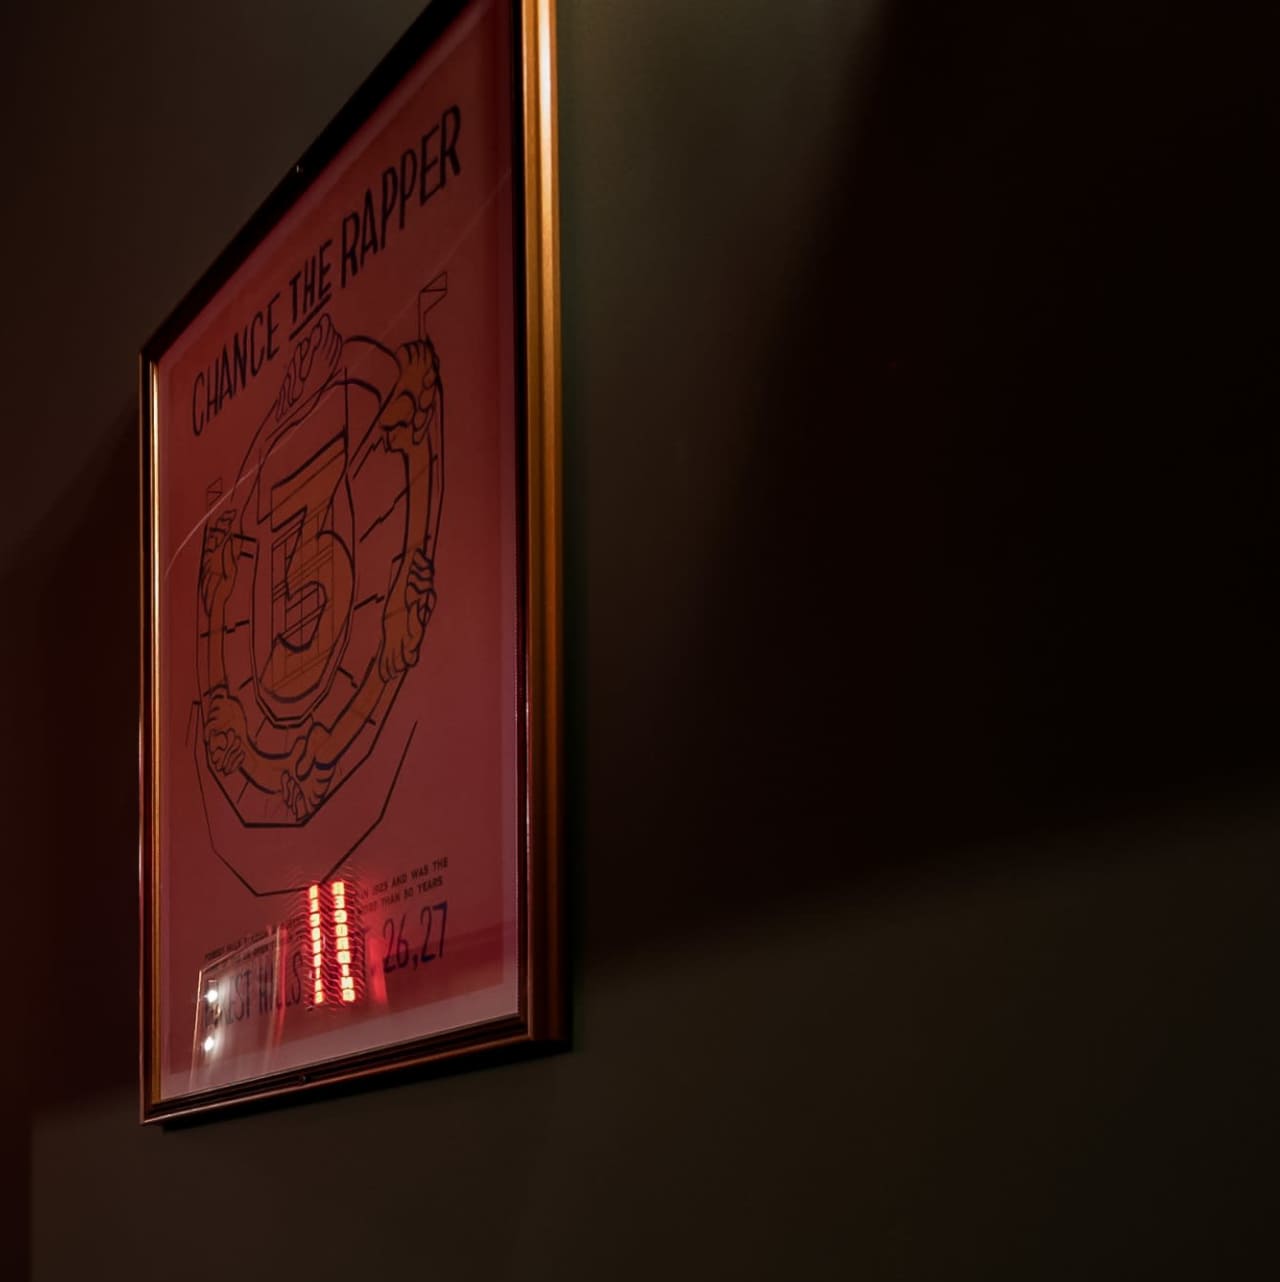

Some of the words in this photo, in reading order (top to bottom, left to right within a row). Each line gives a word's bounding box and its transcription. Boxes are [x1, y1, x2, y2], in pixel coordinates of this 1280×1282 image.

[193, 292, 282, 437] CHANCE
[290, 239, 332, 326] THE
[341, 105, 461, 289] RAPPER
[432, 856, 448, 871] THE
[382, 900, 448, 973] 26,27
